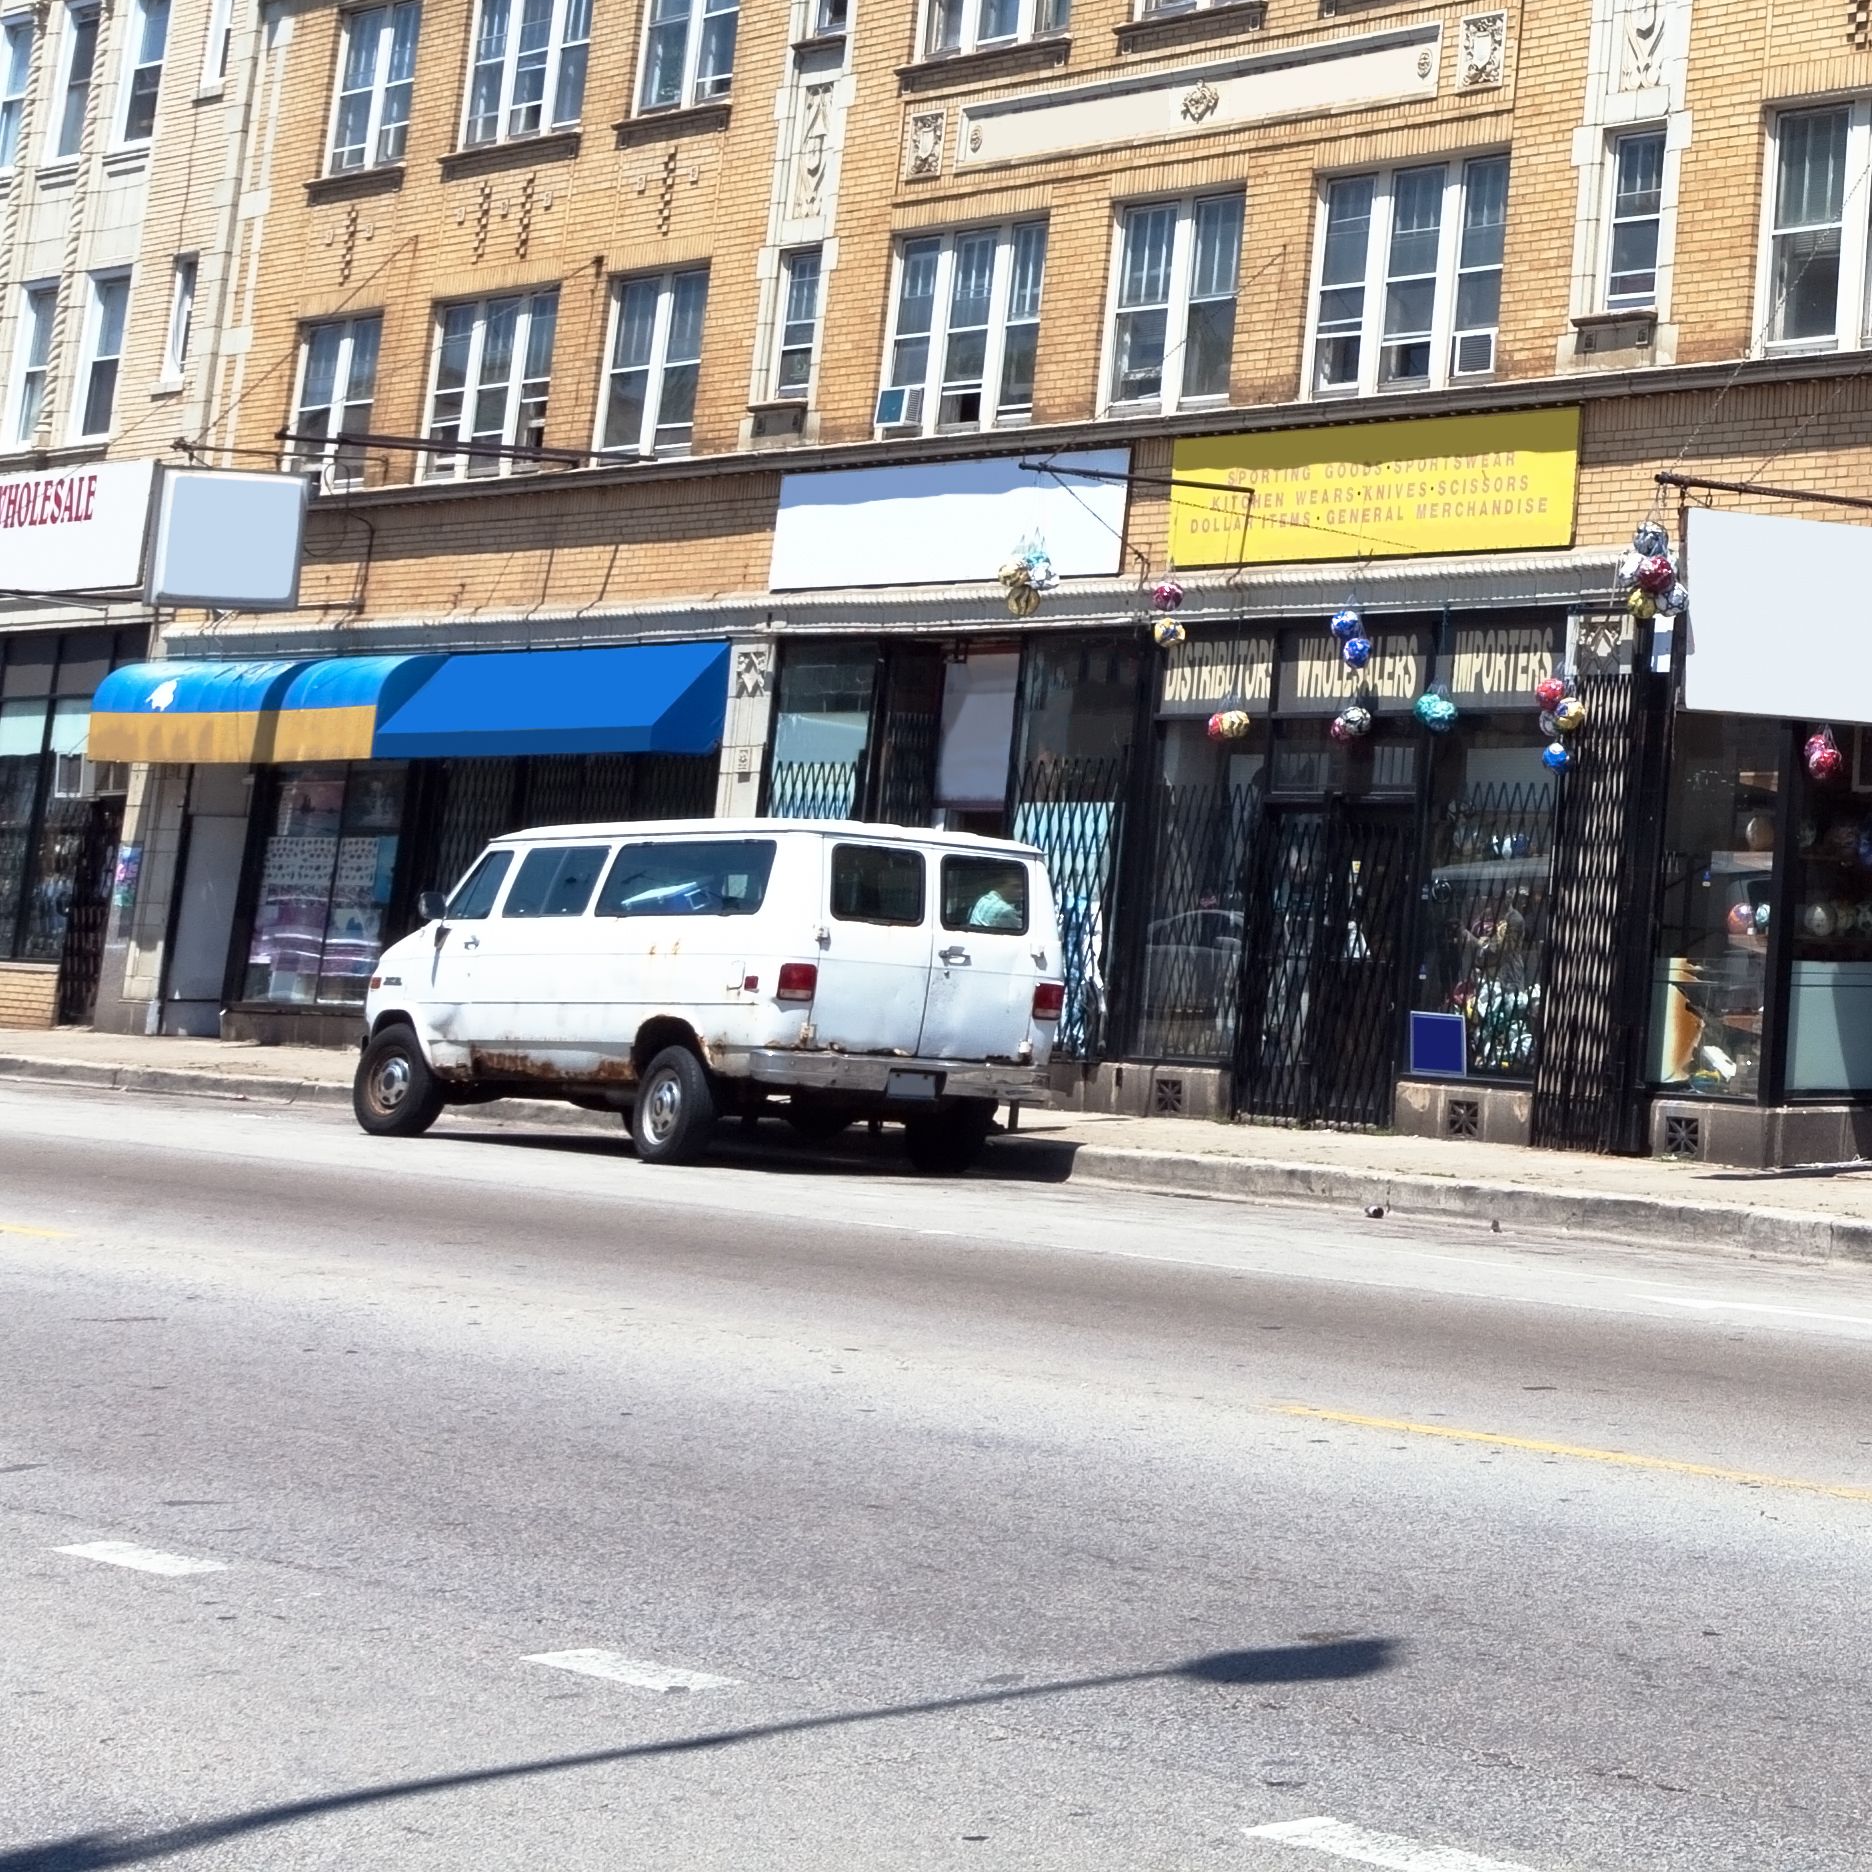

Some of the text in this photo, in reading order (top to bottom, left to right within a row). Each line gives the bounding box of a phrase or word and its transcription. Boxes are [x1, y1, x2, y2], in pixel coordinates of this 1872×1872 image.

[1228, 451, 1515, 485] SPORTING GOODS SPORTSWEAR
[1212, 475, 1528, 510] KITCHEN WEARS KNIVES SCISSORS
[1191, 497, 1548, 534] DOLLAR ITEMS GENERAL MERCHANDISE
[1164, 638, 1275, 702] DISTRIBUTORS
[1452, 628, 1554, 694] IMPORTERS
